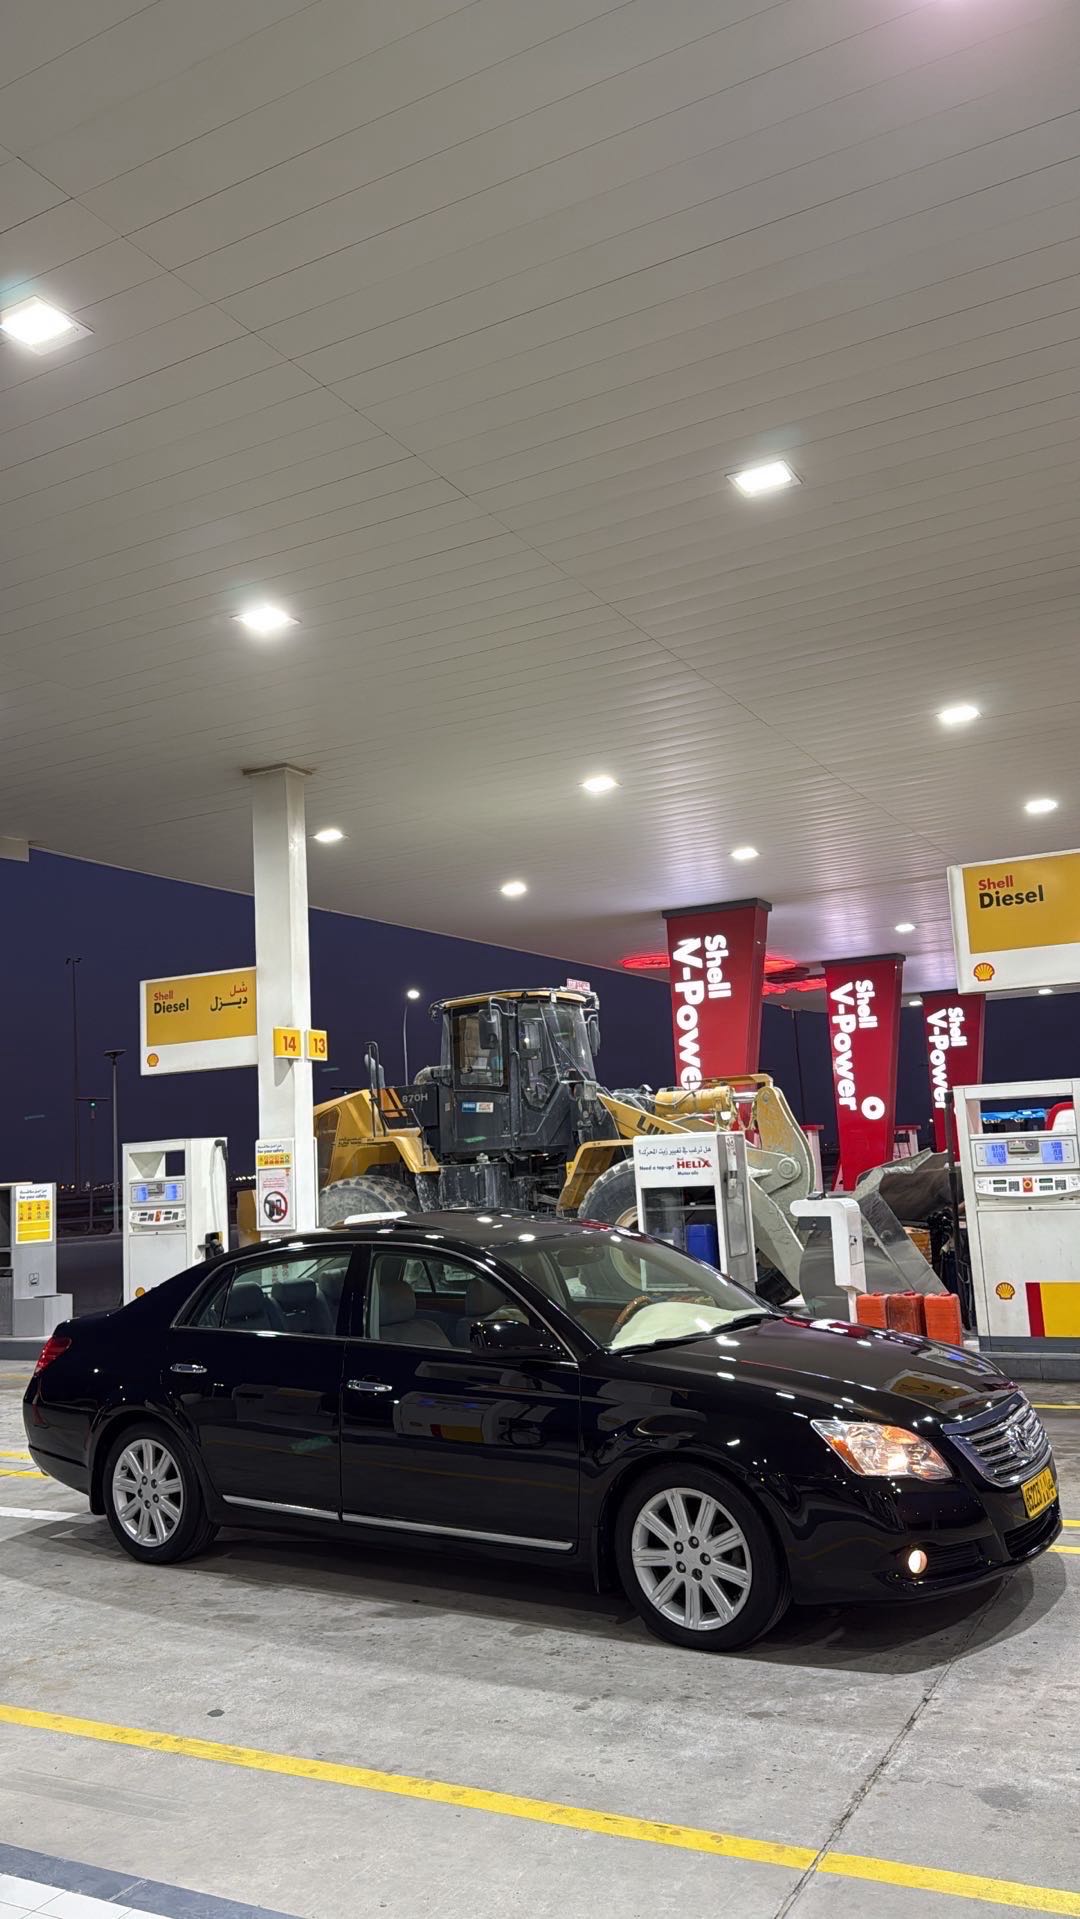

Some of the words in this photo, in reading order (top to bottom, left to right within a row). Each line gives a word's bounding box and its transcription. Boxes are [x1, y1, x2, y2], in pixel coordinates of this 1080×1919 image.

[978, 875, 1014, 891] Shell
[979, 884, 1045, 909] Diesel
[704, 934, 732, 999] Shell
[153, 989, 174, 1001] Shell
[229, 981, 248, 997] شل
[153, 998, 190, 1014] Diesel
[855, 979, 878, 1029] Shell
[672, 937, 705, 1091] V-Powe
[947, 1006, 968, 1047] Shell
[282, 1035, 297, 1052] 14
[313, 1038, 326, 1054] 13
[830, 981, 857, 1111] V-Power
[402, 1093, 428, 1103] 870H
[676, 1160, 712, 1169] HELIX
